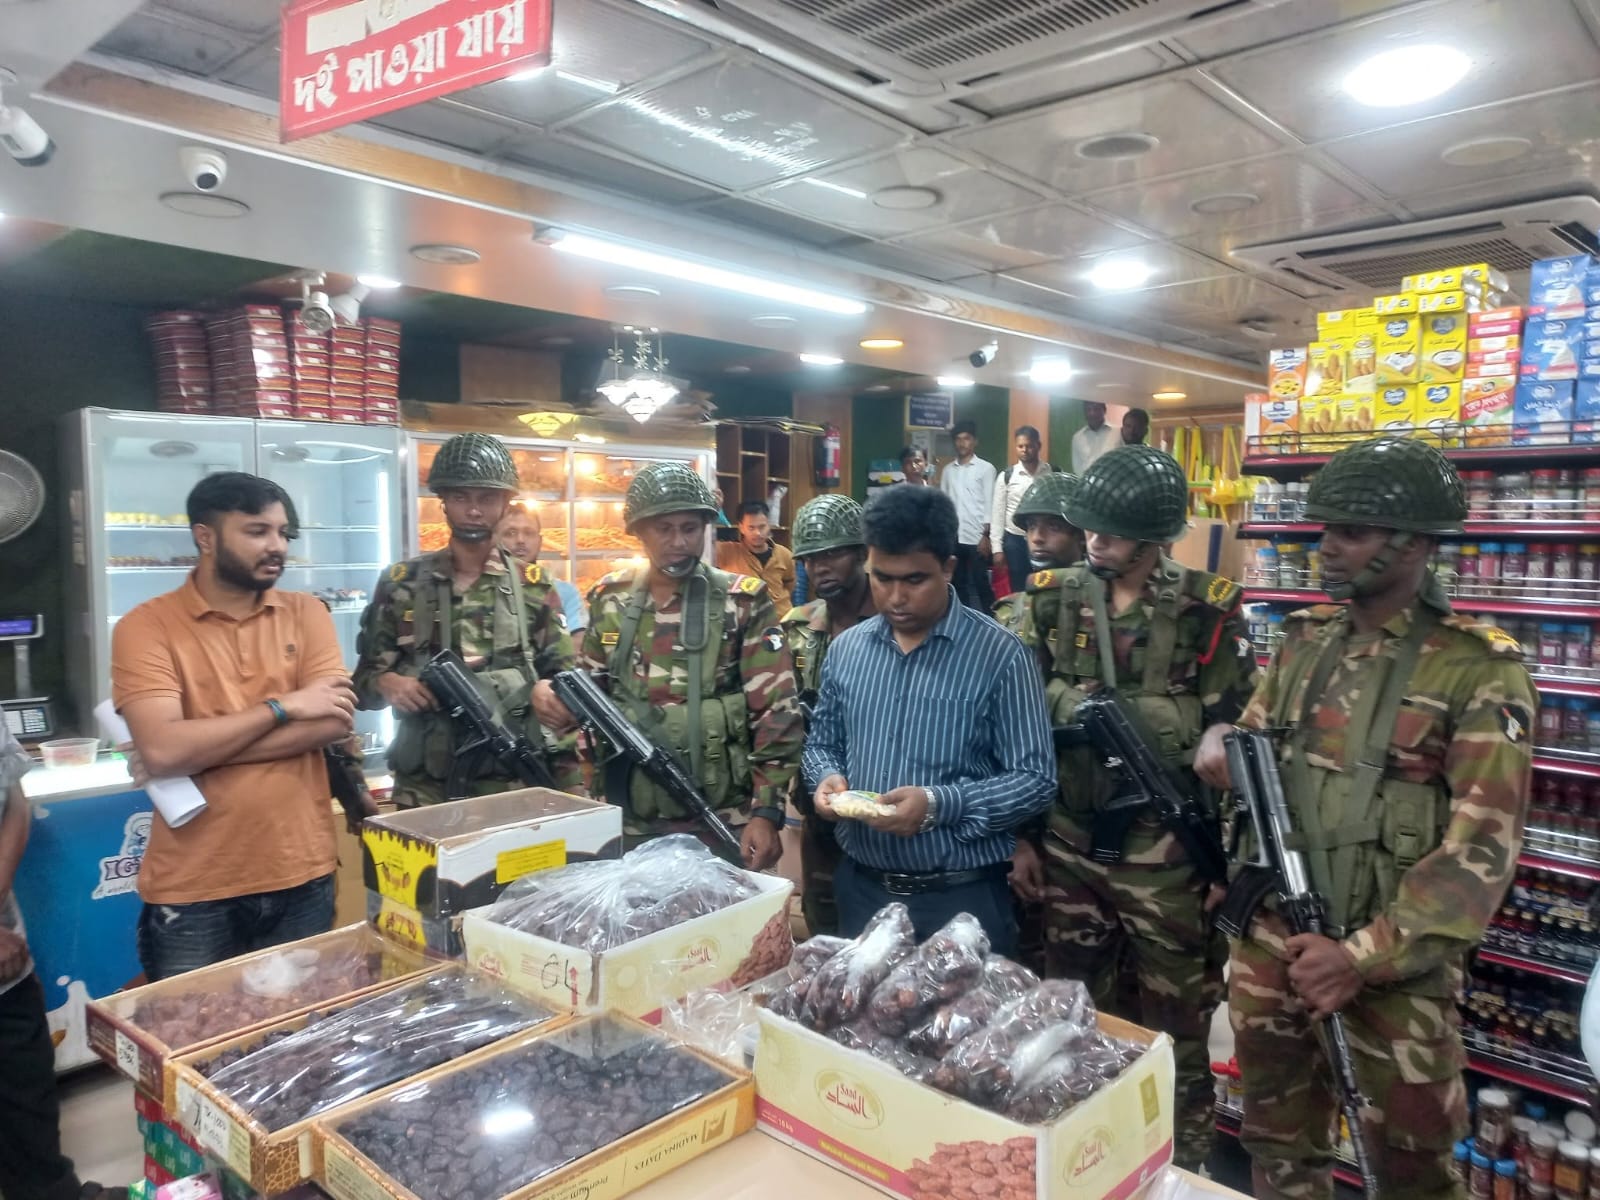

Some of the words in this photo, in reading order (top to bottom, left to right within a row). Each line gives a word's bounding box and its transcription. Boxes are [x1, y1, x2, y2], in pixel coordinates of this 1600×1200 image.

[293, 52, 340, 113] দই
[347, 26, 448, 93] পাওয়া
[455, 0, 525, 57] যায়
